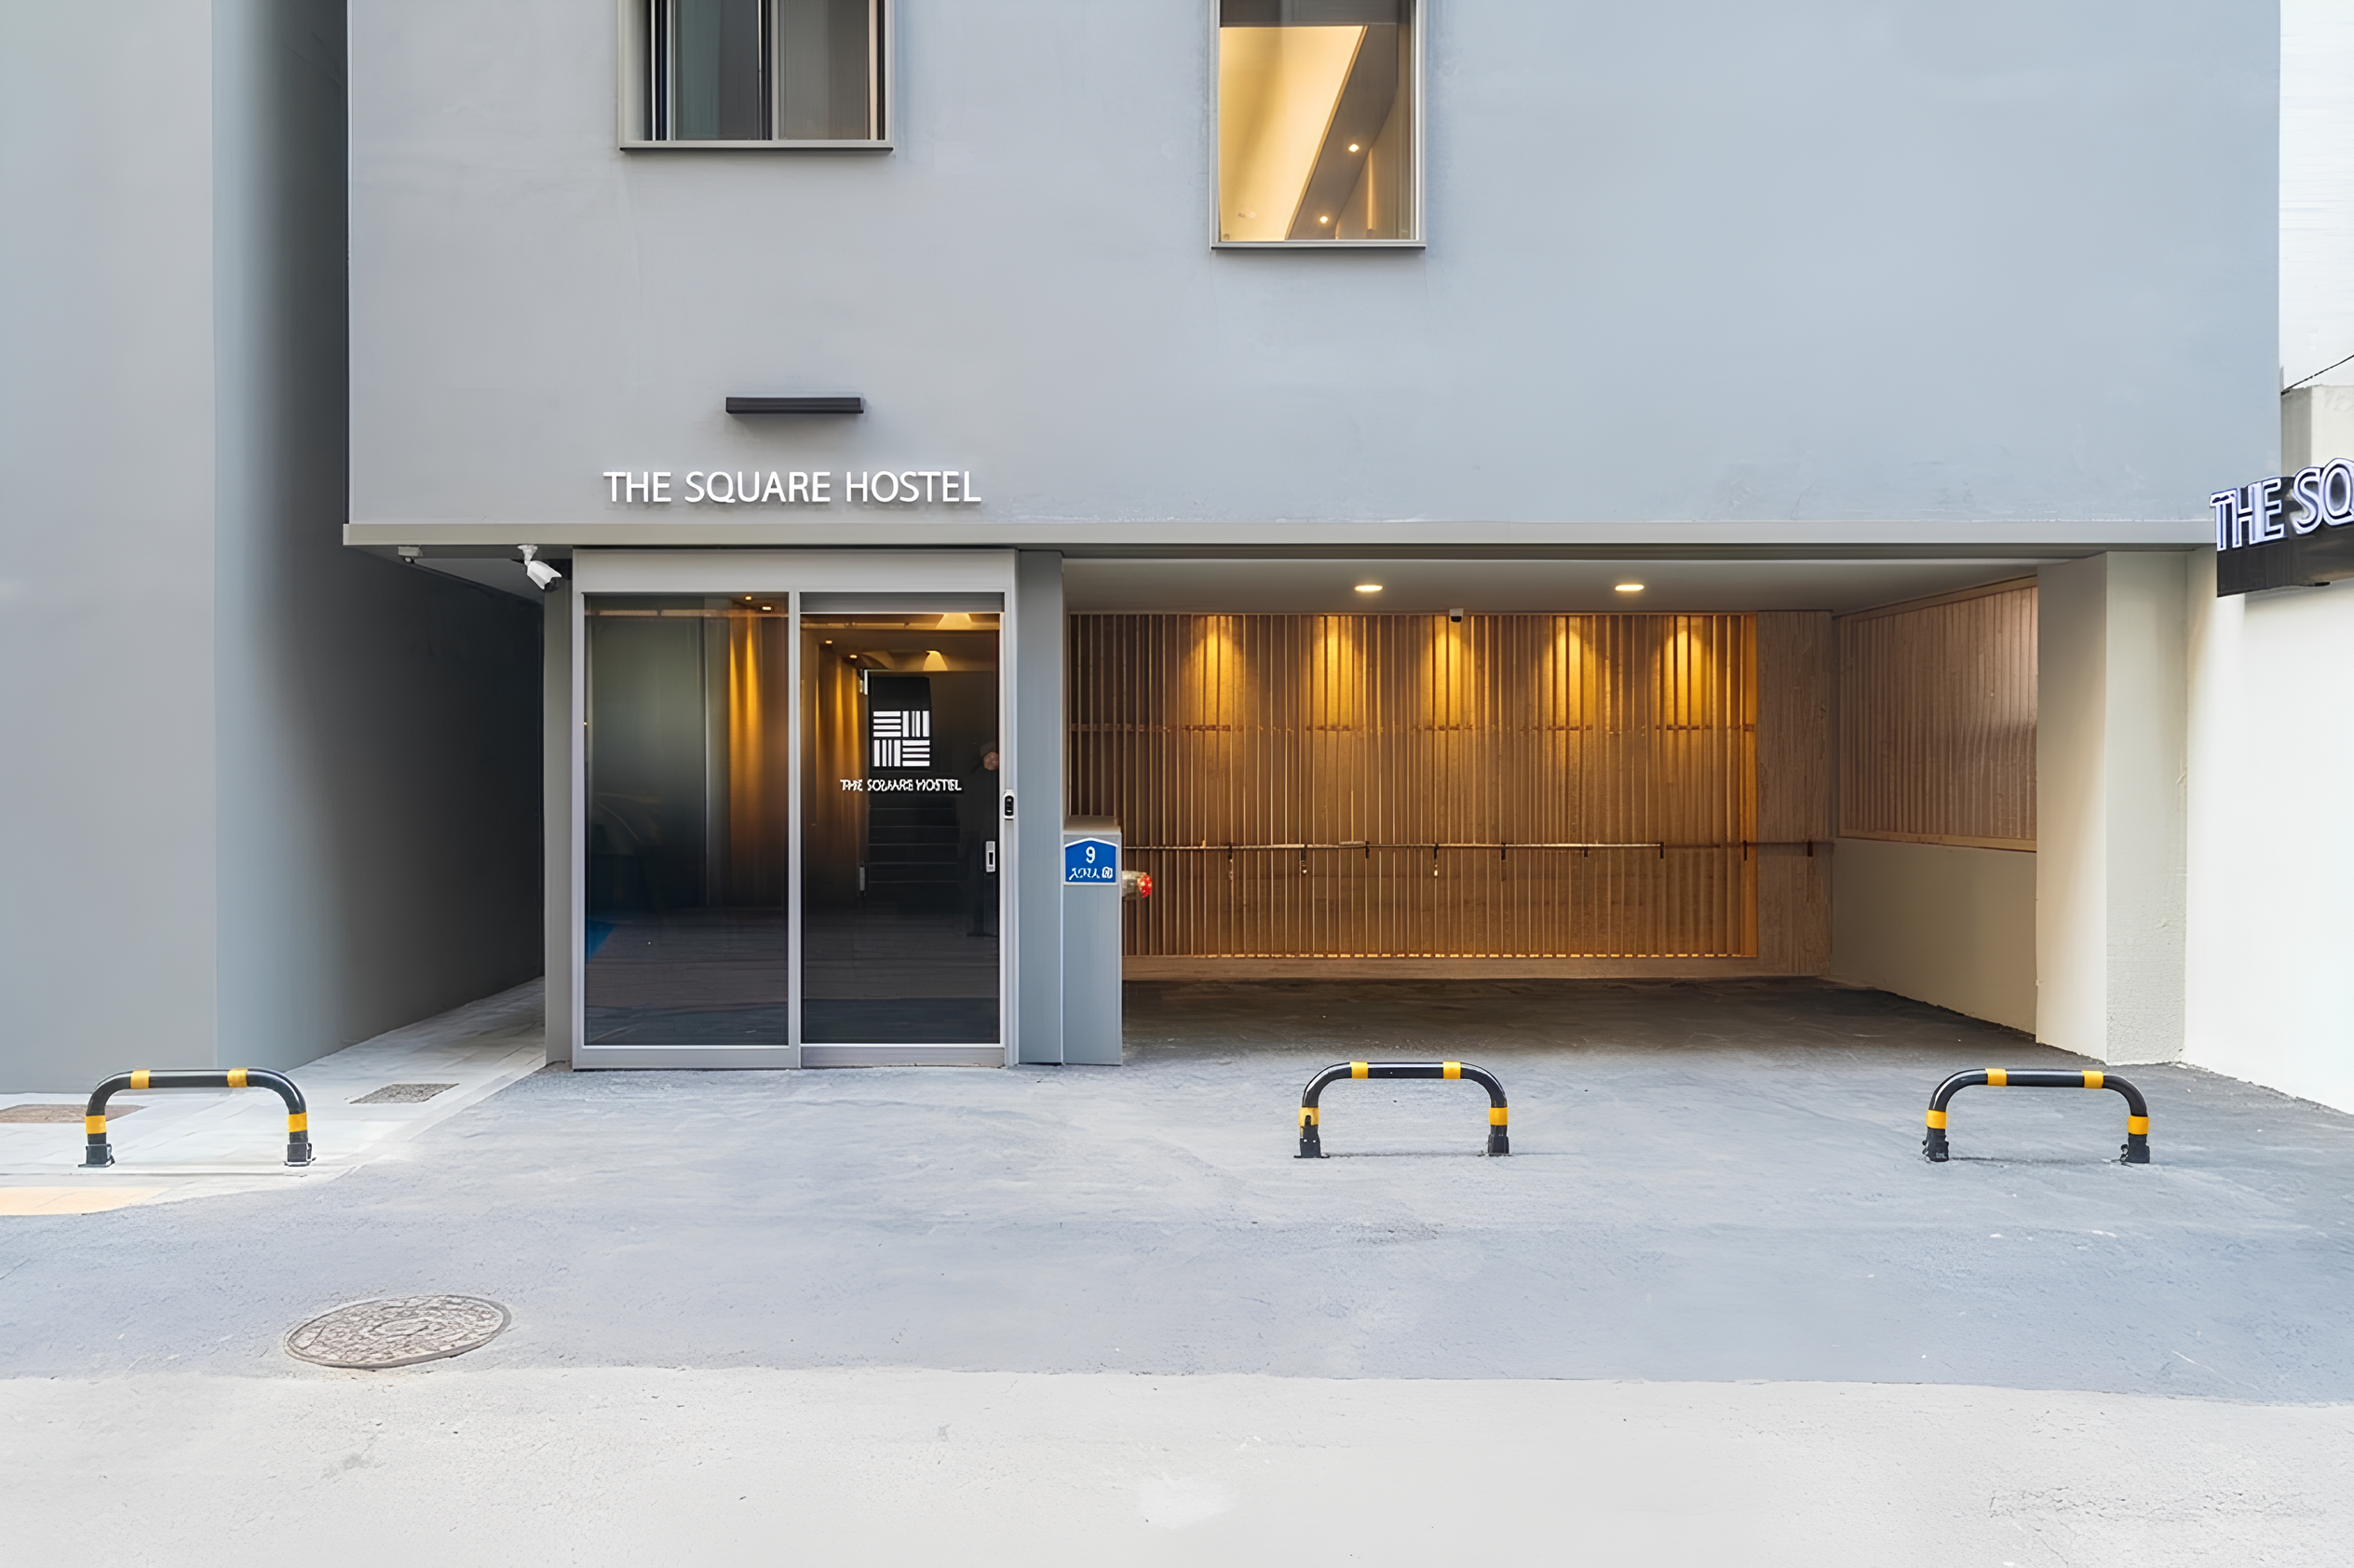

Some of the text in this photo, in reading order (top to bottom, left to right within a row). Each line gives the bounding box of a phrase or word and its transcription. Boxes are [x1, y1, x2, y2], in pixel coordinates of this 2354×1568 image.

[603, 471, 981, 503] THE SQUARE HOSTEL
[2210, 478, 2285, 551] THE
[840, 778, 962, 791] THE SQUARE HOSTEL
[1086, 845, 1096, 864] 9
